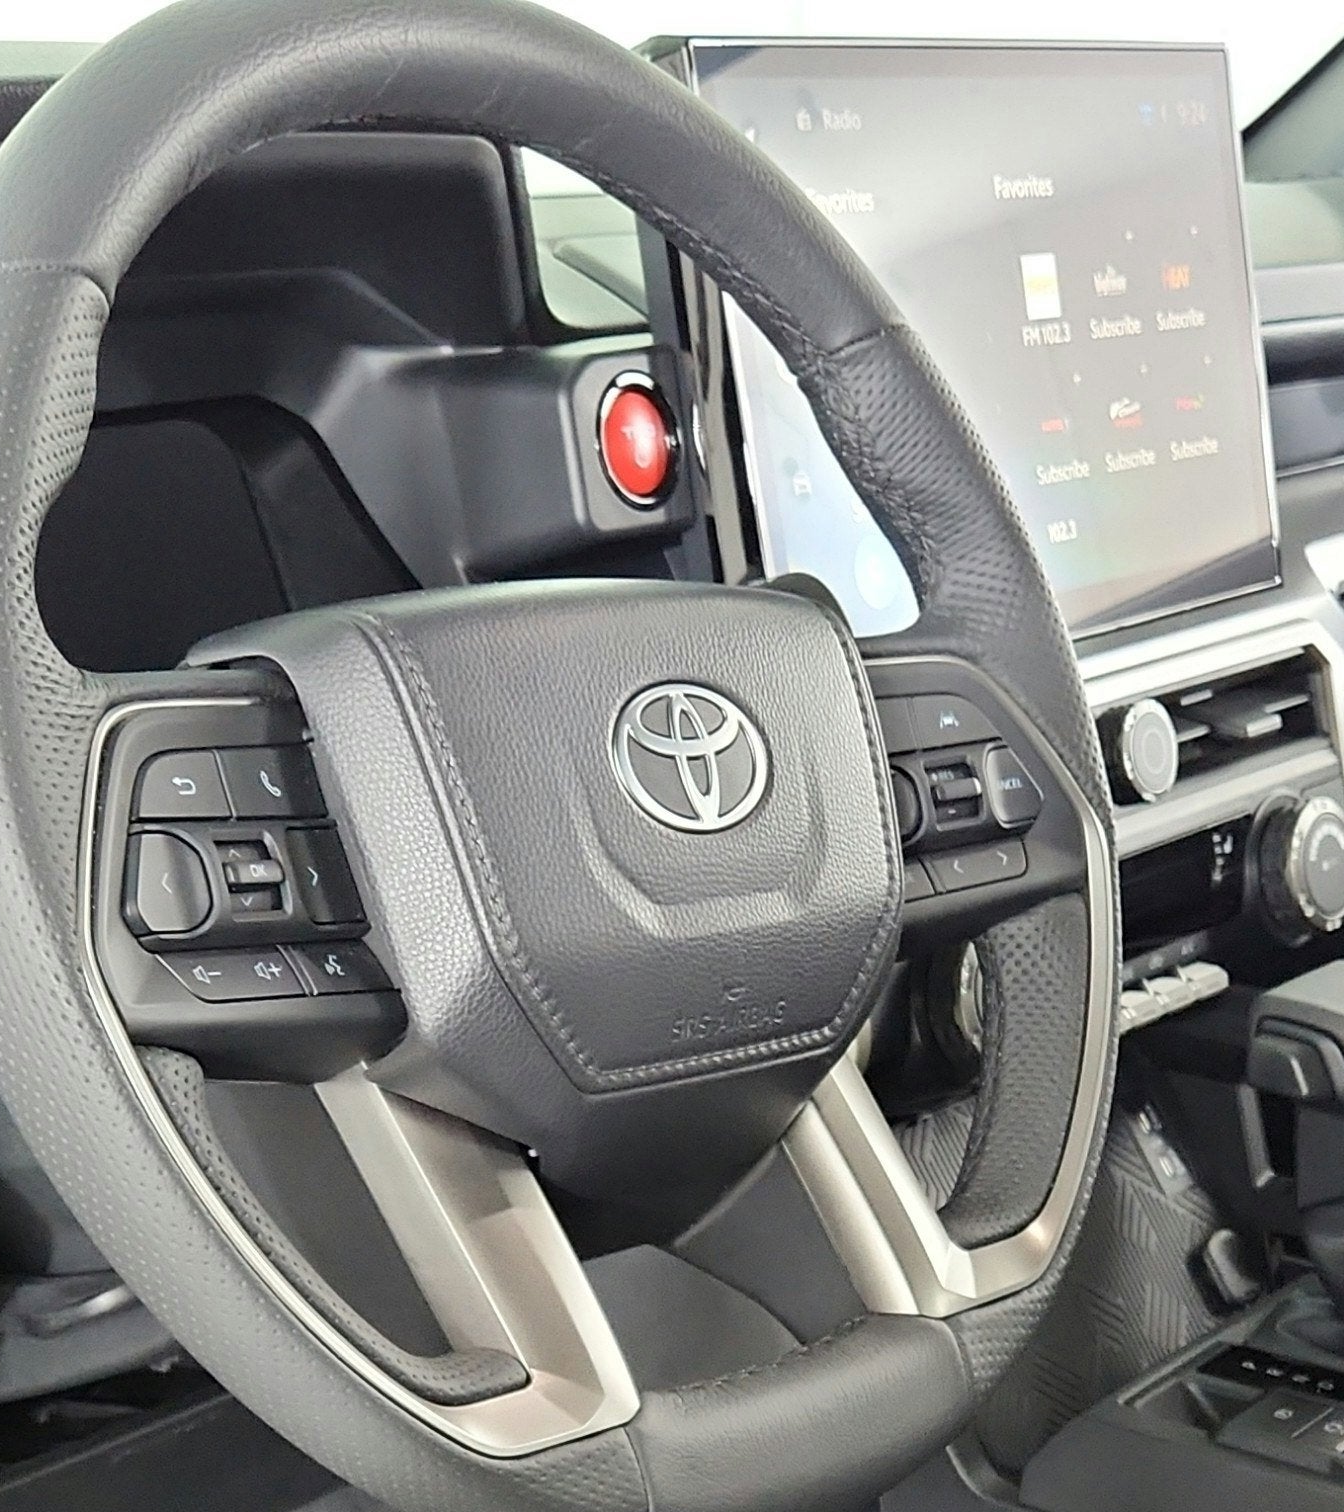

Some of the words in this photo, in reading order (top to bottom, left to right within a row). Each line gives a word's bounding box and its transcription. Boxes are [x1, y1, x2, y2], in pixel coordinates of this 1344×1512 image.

[822, 108, 862, 131] Radio
[993, 174, 1054, 200] Favorites
[1089, 314, 1142, 340] Subscribe
[1155, 306, 1206, 332] Subscribe
[1022, 325, 1041, 347] FM
[1042, 322, 1072, 345] 102.3
[1105, 448, 1157, 473] Subscribe
[1169, 436, 1219, 461] Subscribe
[1036, 459, 1090, 486] Subscribe
[249, 862, 269, 878] OK
